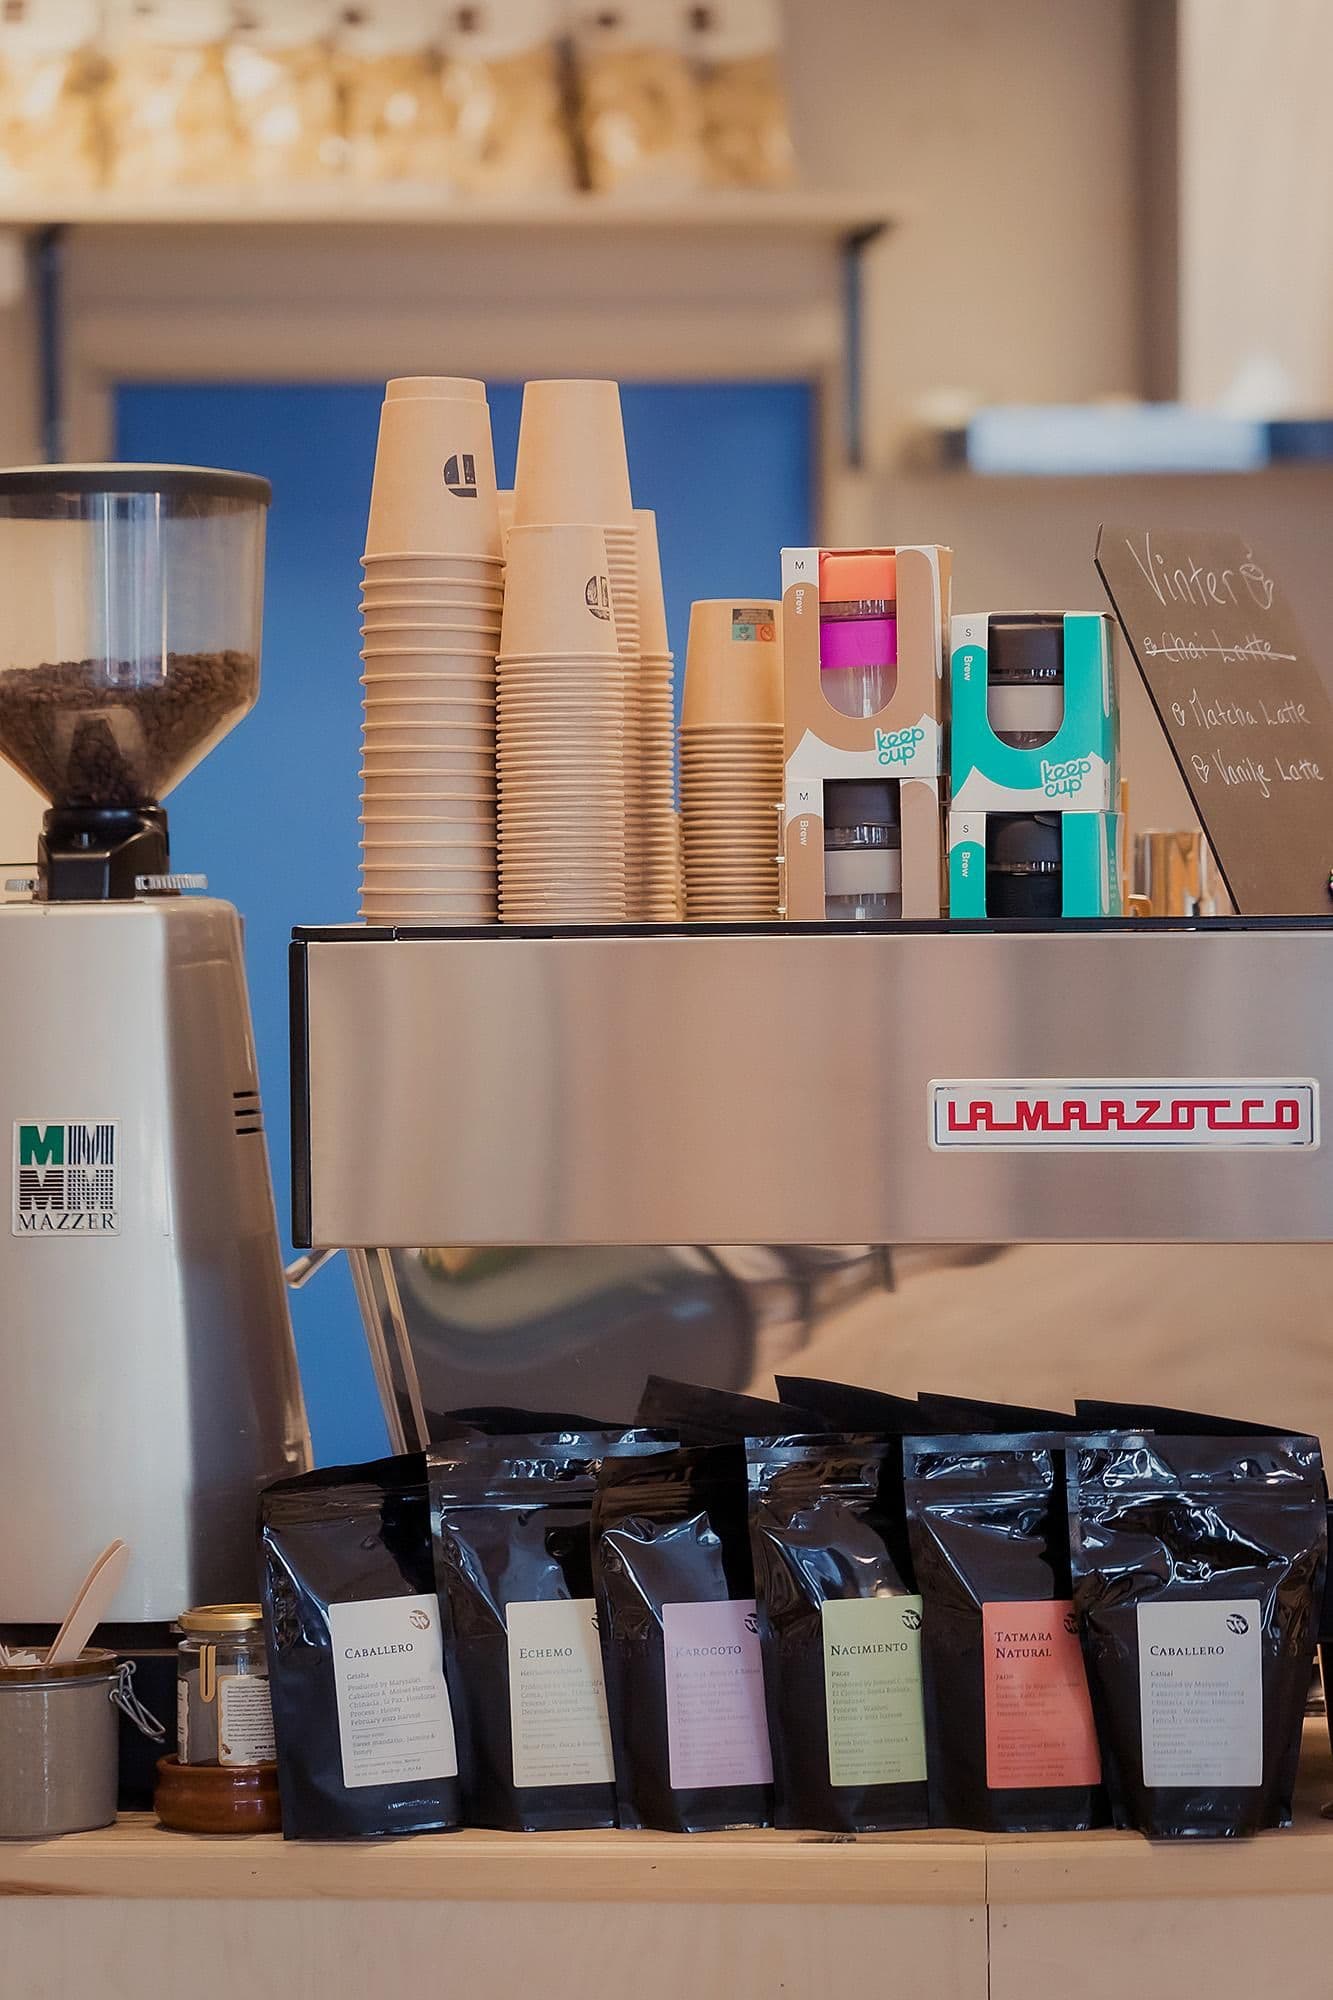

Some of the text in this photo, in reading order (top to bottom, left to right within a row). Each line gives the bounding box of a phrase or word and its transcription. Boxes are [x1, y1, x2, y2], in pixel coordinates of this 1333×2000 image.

[794, 561, 805, 570] M
[1125, 532, 1239, 606] Vinter
[795, 589, 805, 615] Brew
[965, 628, 972, 637] S
[1161, 629, 1278, 663] Chai Latte
[963, 655, 973, 681] Brew
[1259, 700, 1311, 725] Latte
[875, 727, 925, 751] keep
[878, 746, 916, 766] cup
[1041, 759, 1092, 784] keep
[1276, 757, 1324, 782] Latte
[799, 792, 808, 801] M
[1044, 780, 1082, 798] cup
[799, 820, 809, 846] Brew
[962, 824, 969, 833] S
[961, 851, 970, 878] Brew
[948, 1100, 1299, 1131] LA MARZOCCO
[19, 1213, 115, 1230] MAZZER
[994, 1631, 1052, 1642] TATMARA
[344, 1643, 414, 1660] CABALLERO
[519, 1647, 573, 1659] ECHEMO
[830, 1642, 908, 1656] NACIMIENTO
[995, 1648, 1052, 1659] NATURAL
[1150, 1645, 1225, 1656] CABALLERO
